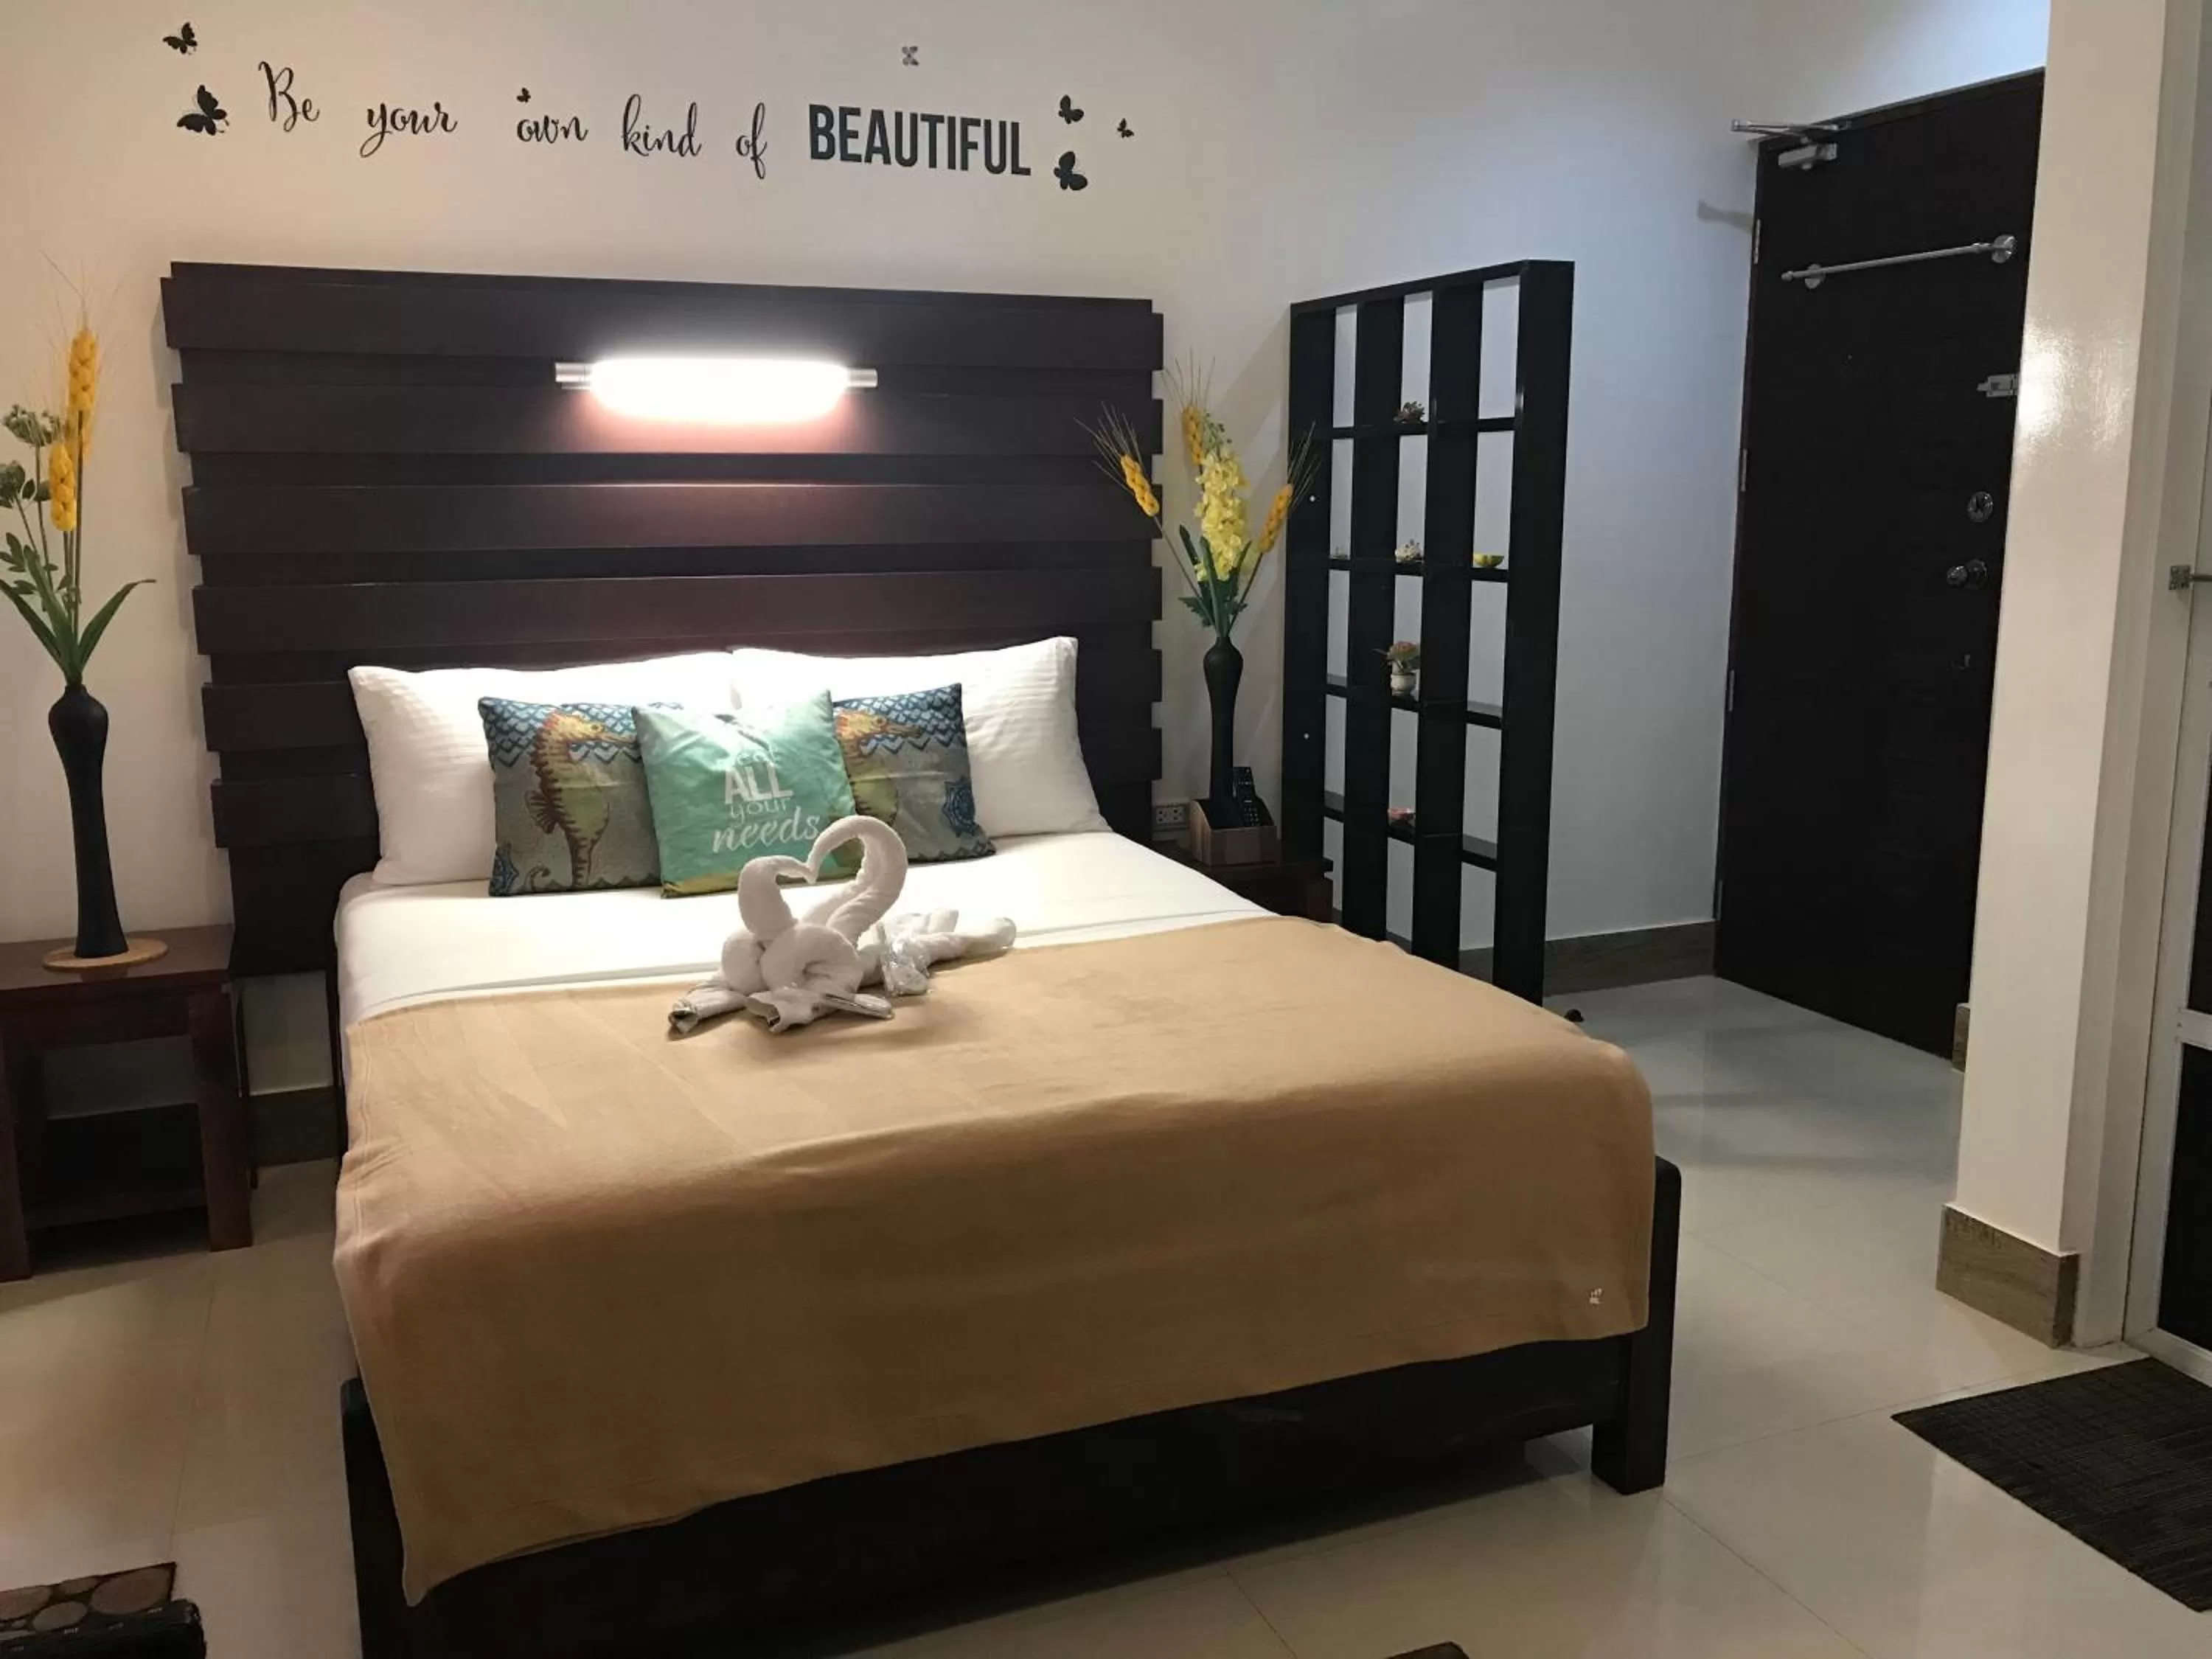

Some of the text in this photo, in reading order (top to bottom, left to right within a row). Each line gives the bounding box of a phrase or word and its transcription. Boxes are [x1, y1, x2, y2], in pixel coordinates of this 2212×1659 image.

[258, 61, 1032, 180] Be your own kind of BEAUTIFUL
[724, 764, 794, 804] ALL
[712, 806, 821, 853] needs
[730, 797, 792, 825] your
